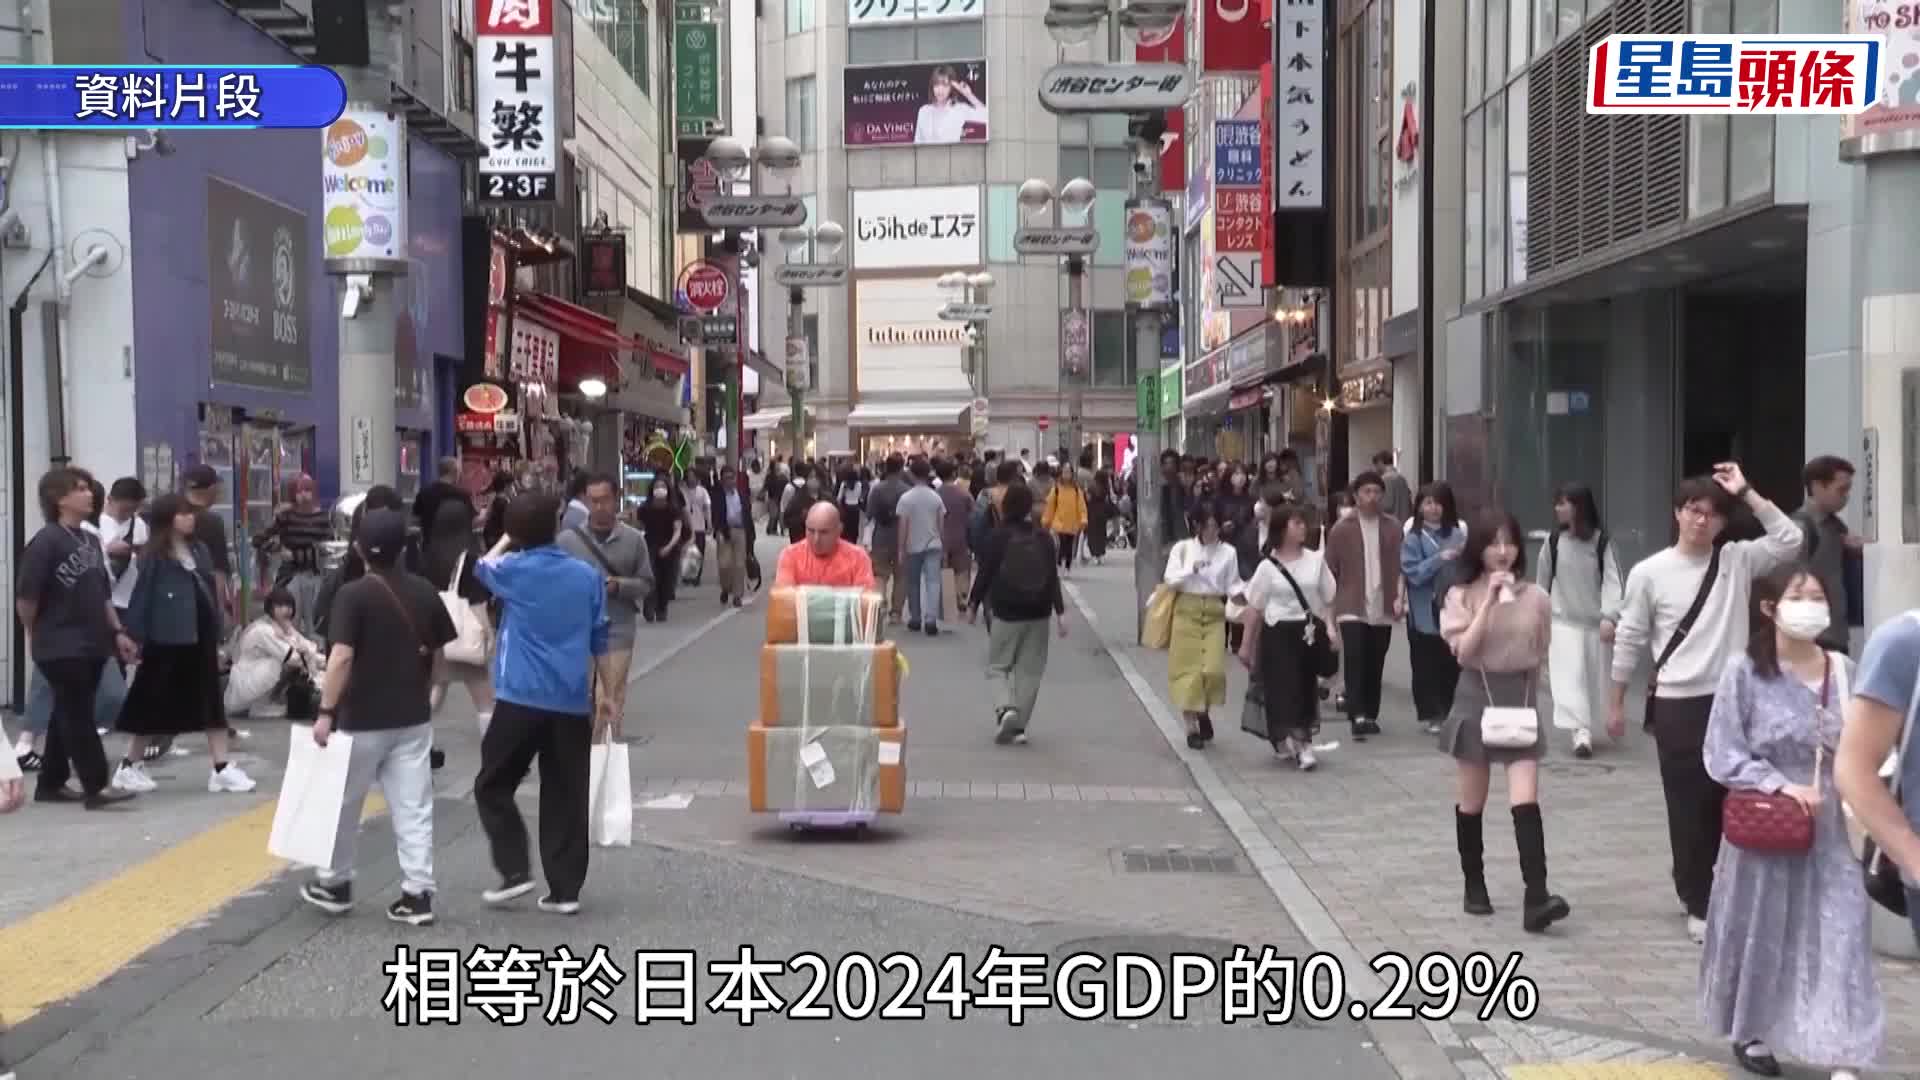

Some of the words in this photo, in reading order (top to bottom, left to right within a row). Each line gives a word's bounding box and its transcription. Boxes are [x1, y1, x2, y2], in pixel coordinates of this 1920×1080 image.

[1049, 74, 1182, 94] 渋谷センター街
[492, 41, 543, 151] 牛繁
[1286, 0, 1314, 197] 下本気うどん
[324, 173, 395, 193] Welcome
[1217, 168, 1262, 182] クリニック
[1235, 193, 1261, 213] 渋谷
[1216, 216, 1262, 232] コンタクト
[272, 310, 298, 344] BOSS
